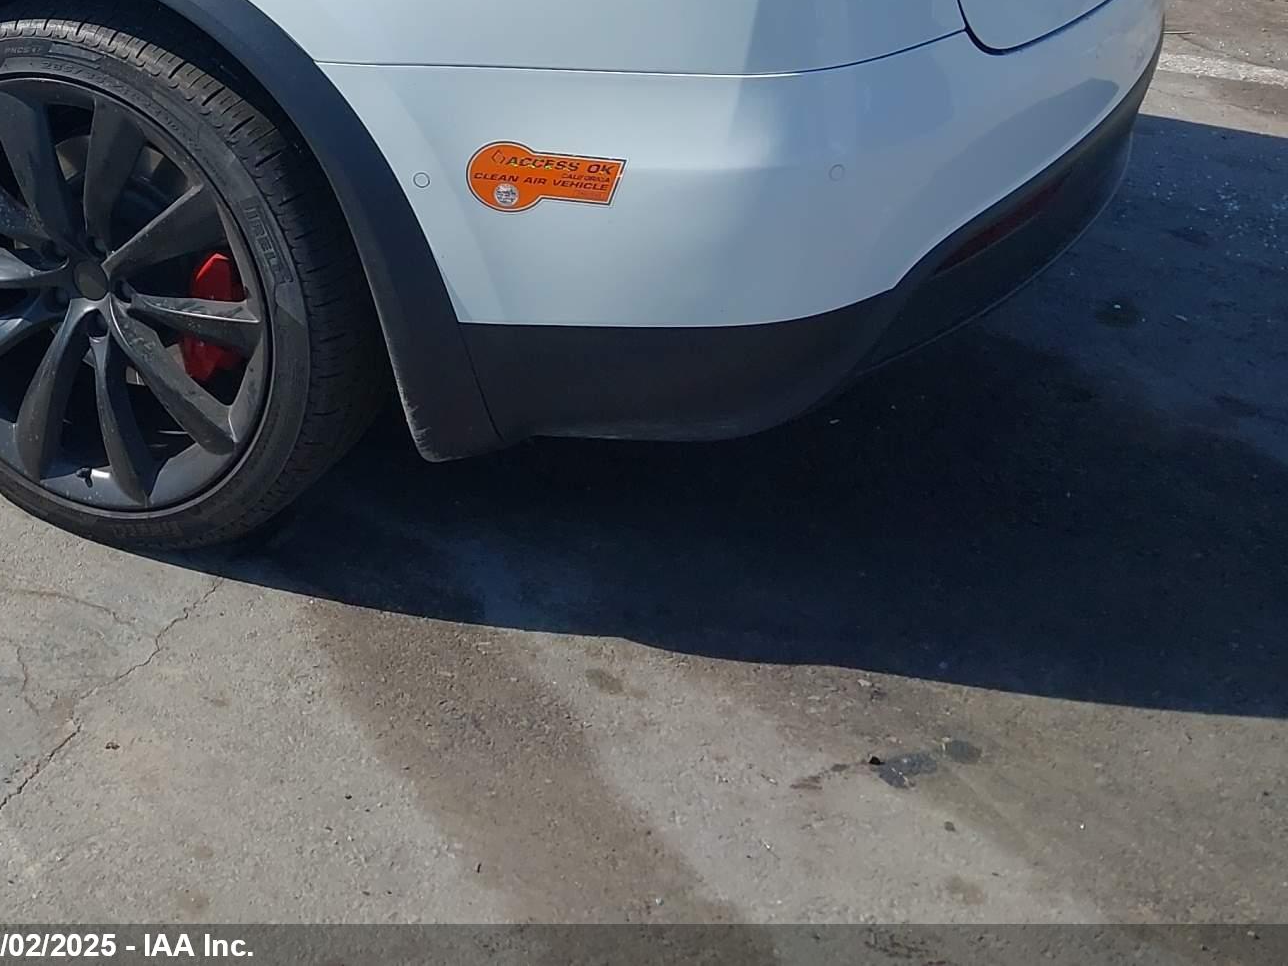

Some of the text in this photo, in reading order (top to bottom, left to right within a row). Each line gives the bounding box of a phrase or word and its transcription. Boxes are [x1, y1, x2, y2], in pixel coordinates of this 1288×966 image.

[506, 156, 616, 175] ACCESS OK
[473, 172, 609, 191] CLEAN AIR VEHICLE
